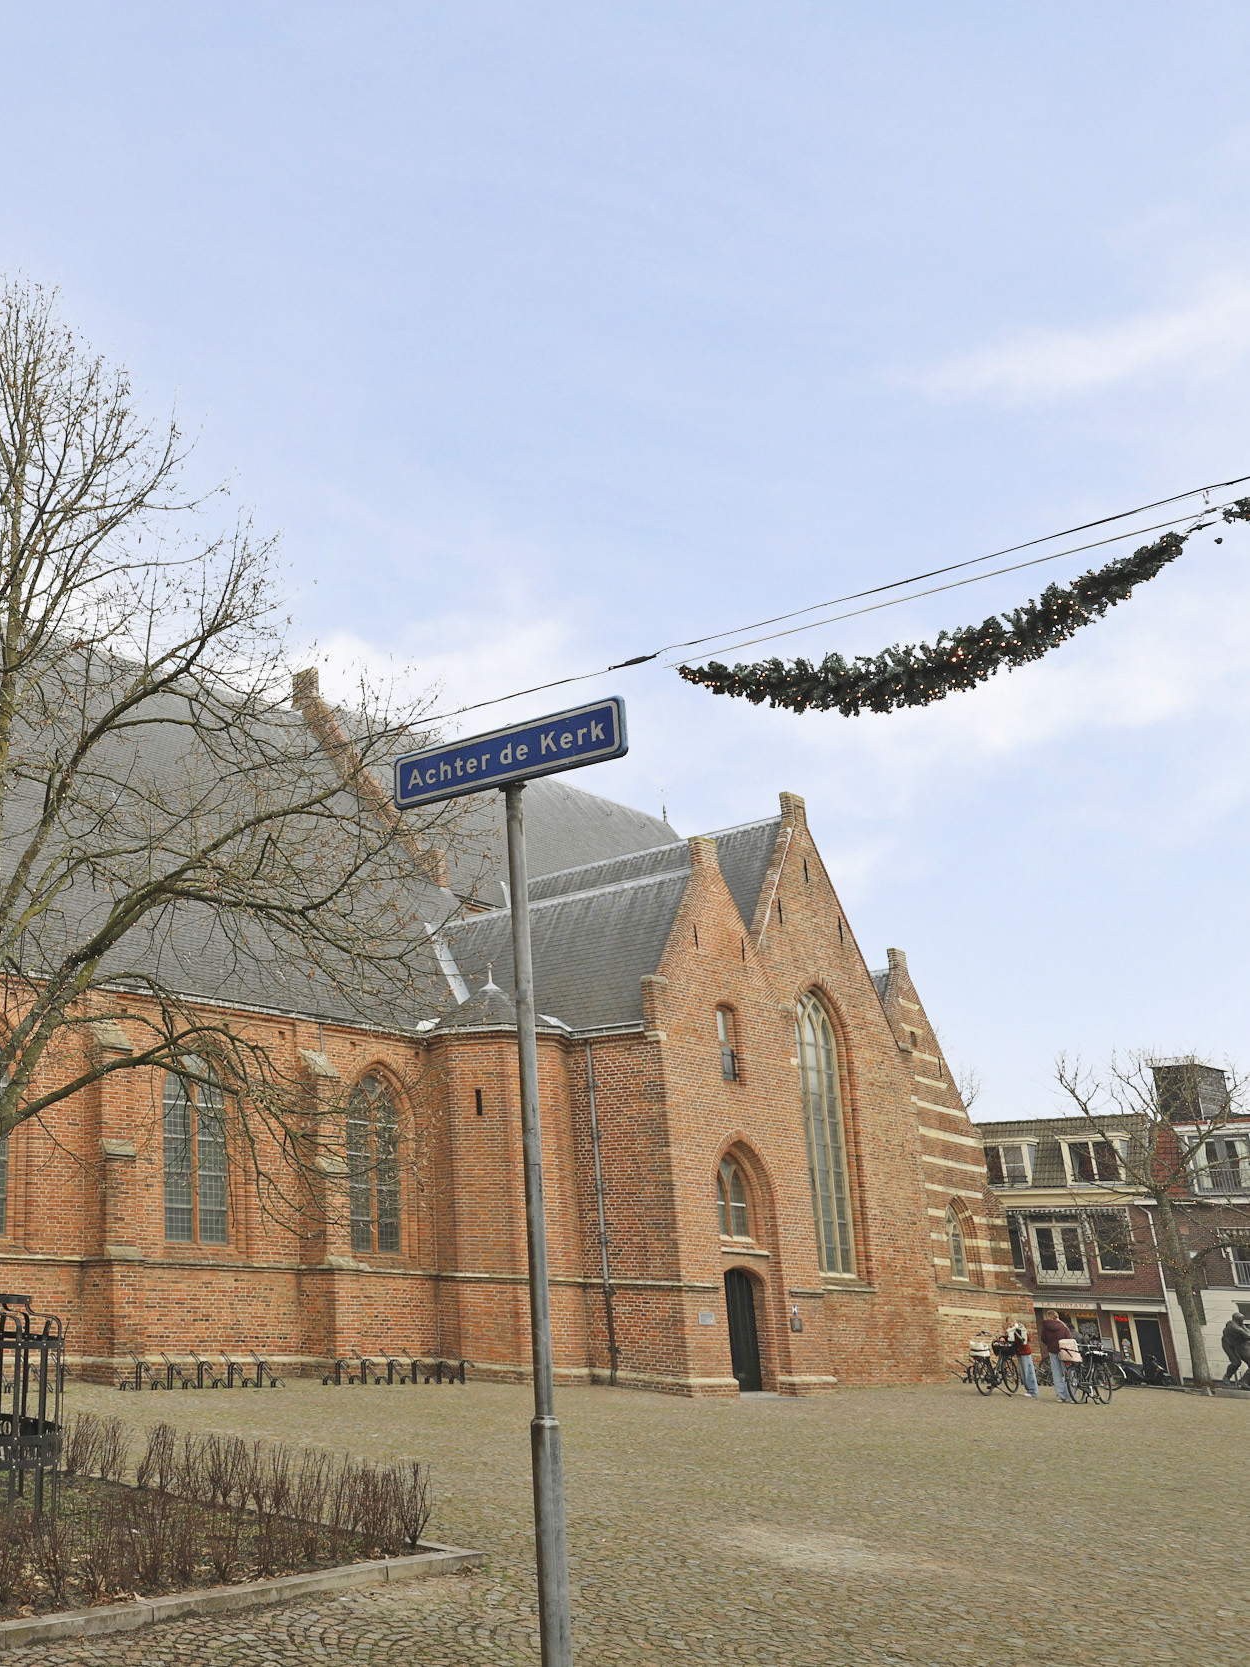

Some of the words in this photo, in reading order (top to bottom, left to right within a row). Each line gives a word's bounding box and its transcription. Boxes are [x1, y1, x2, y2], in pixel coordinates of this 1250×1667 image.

[407, 753, 491, 790] Achter
[499, 742, 529, 765] de
[540, 720, 606, 755] Kerk
